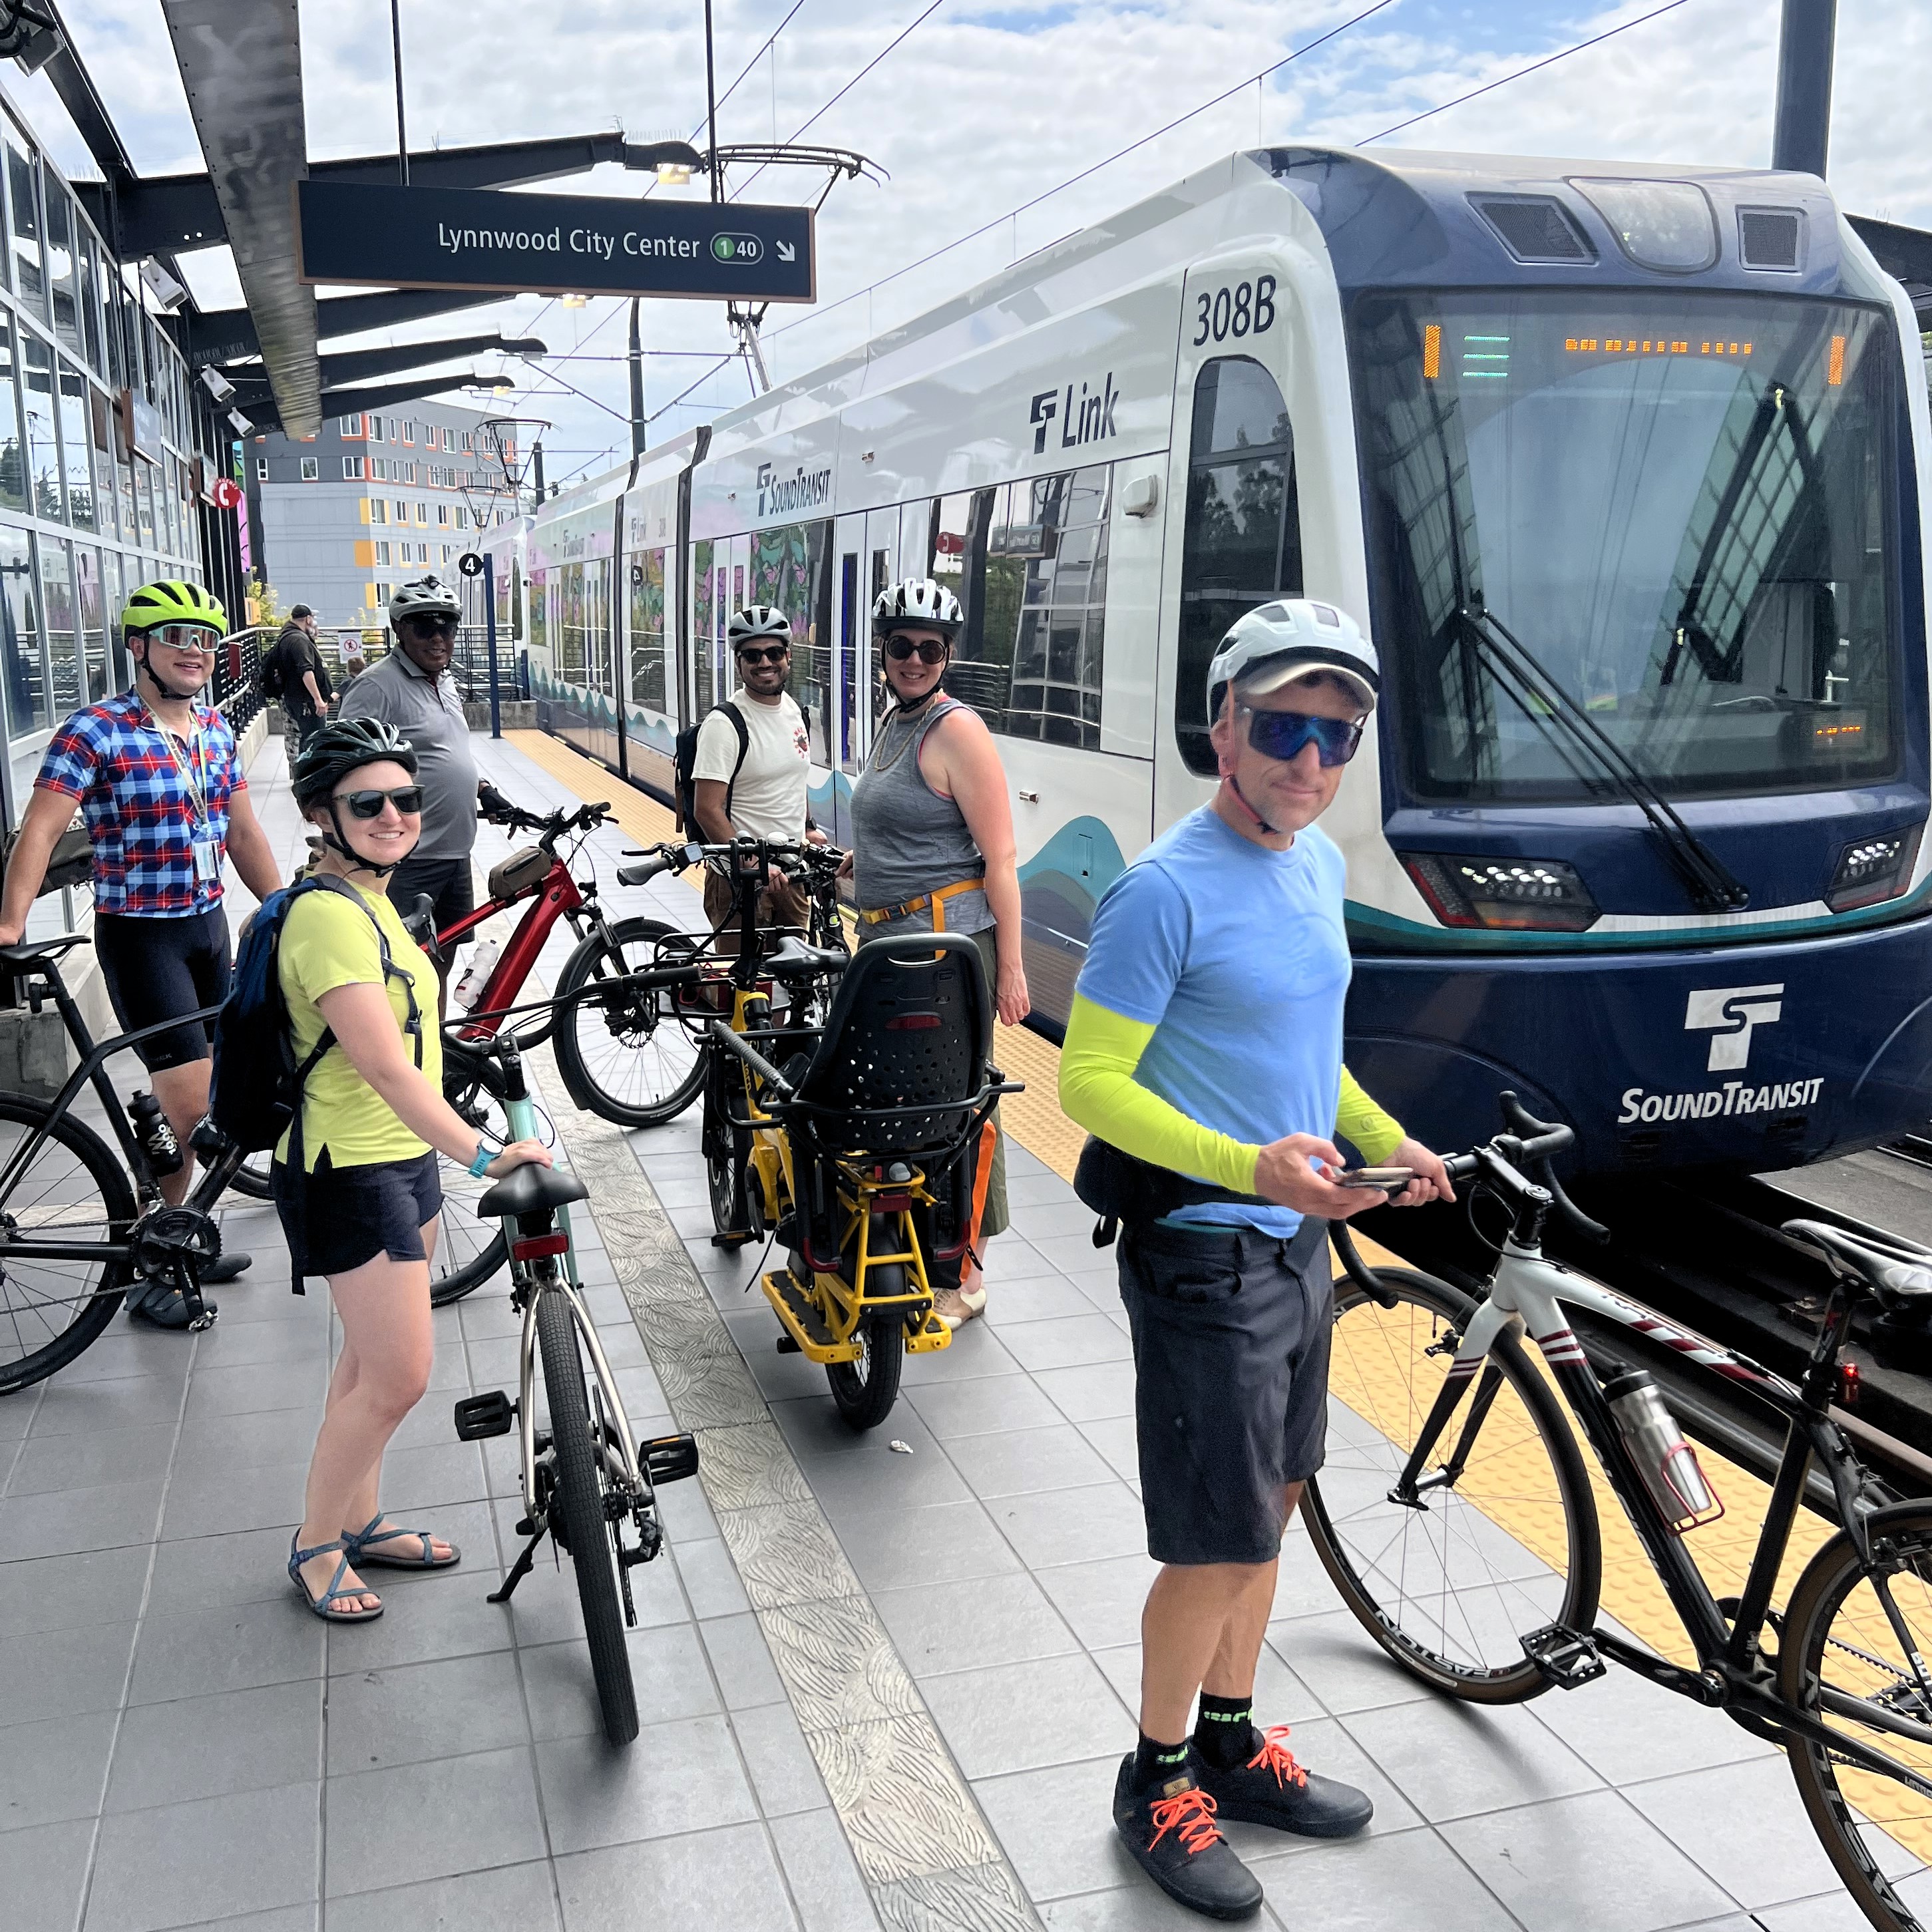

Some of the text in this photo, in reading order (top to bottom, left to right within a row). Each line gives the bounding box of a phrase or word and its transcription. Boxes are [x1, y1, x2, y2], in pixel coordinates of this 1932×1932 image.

[439, 222, 757, 260] Lynnwood City Center 1 40
[1193, 274, 1276, 347] 308B
[1062, 371, 1120, 449] Link
[769, 467, 831, 516] SOUNDTRANSIT
[465, 557, 476, 573] 4
[1617, 1077, 1825, 1123] SOUNDTRANSIT
